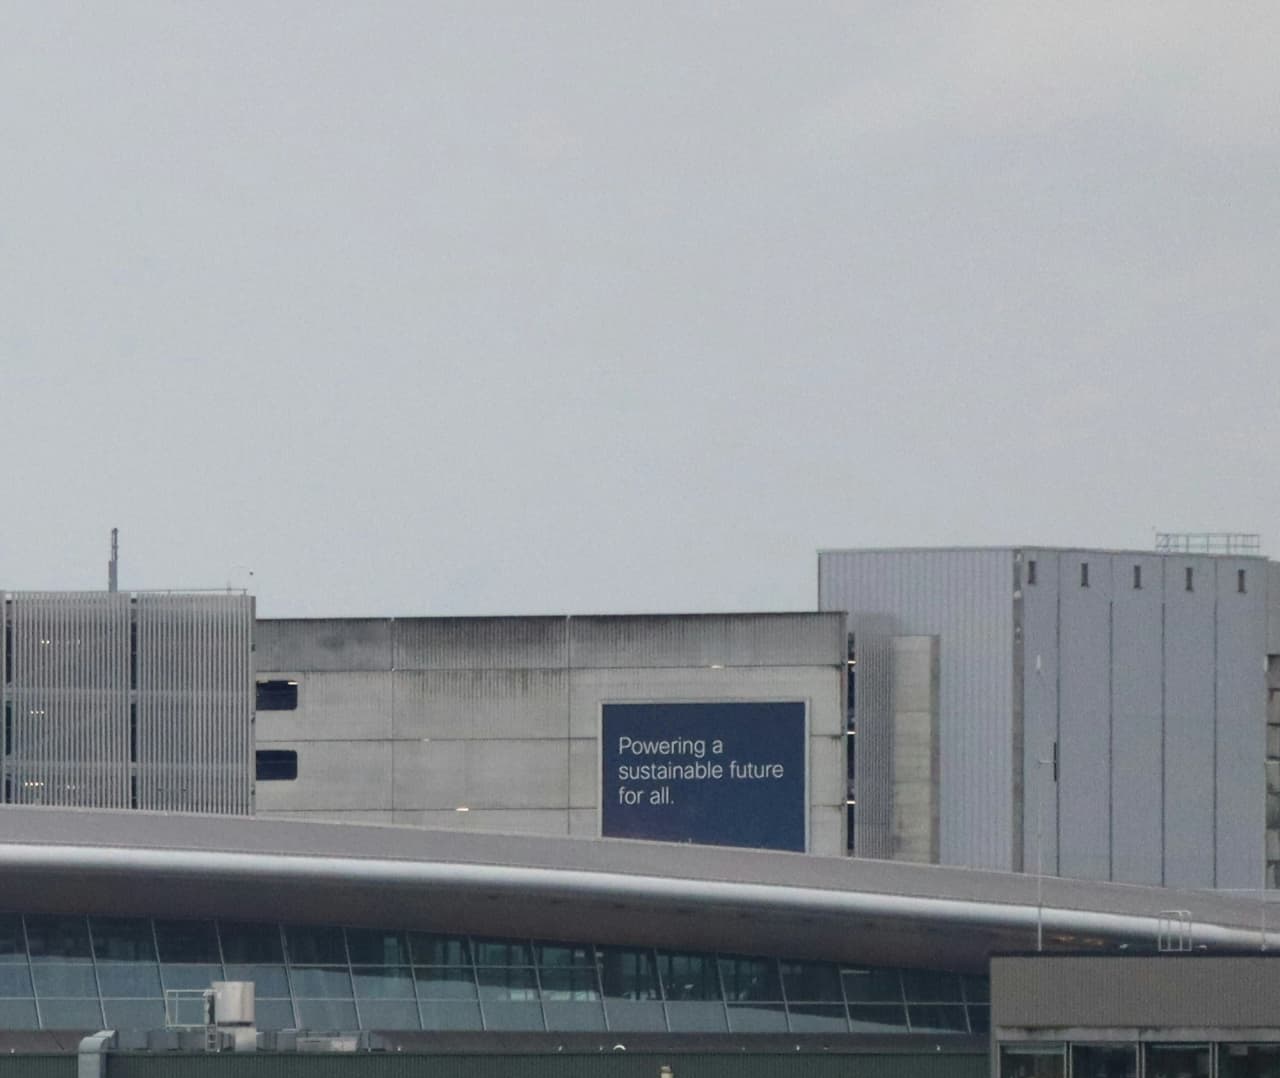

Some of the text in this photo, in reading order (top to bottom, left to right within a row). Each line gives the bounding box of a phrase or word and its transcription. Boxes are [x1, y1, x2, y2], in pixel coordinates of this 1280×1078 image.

[618, 736, 724, 758] Powering a
[618, 760, 784, 780] sustainable future
[618, 786, 675, 805] for all.
